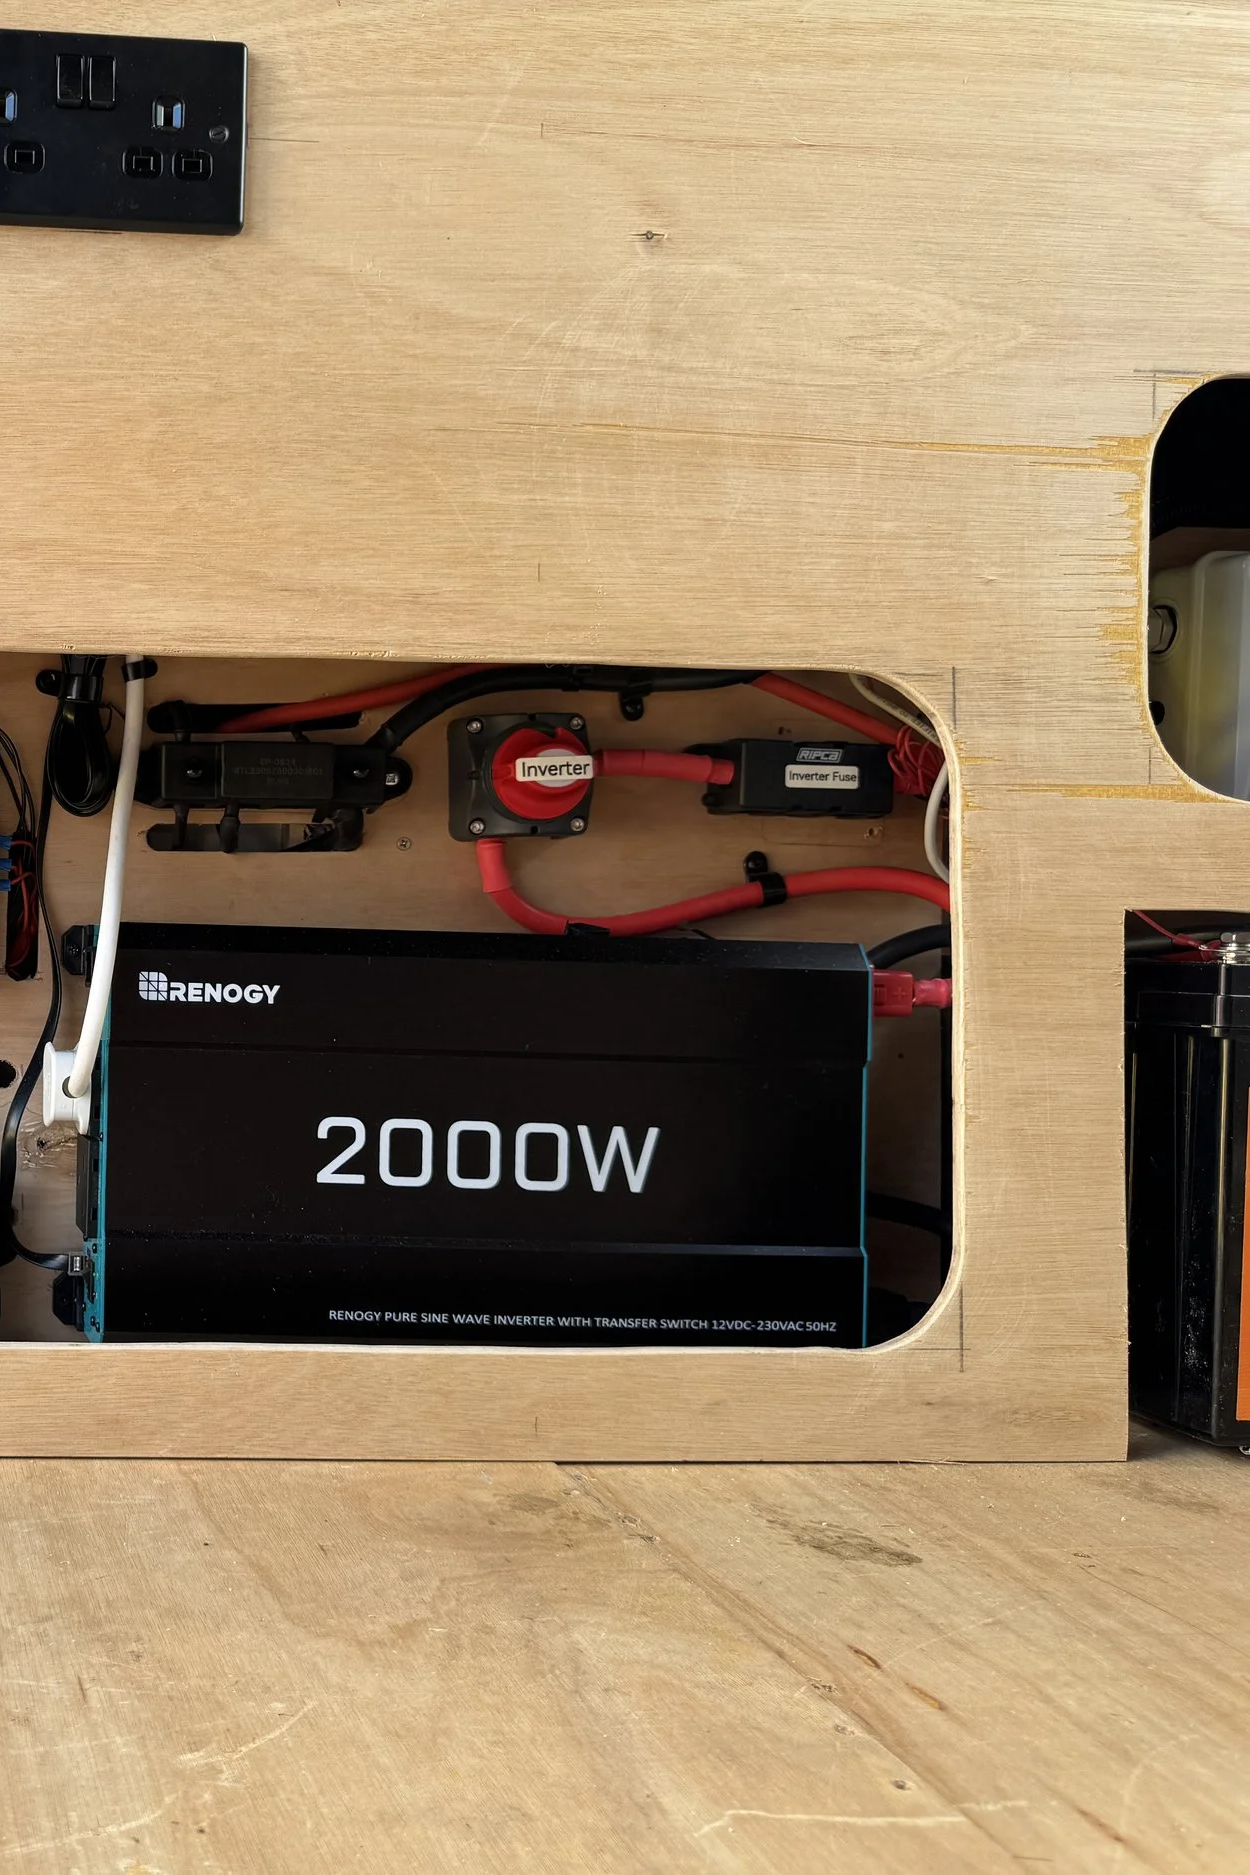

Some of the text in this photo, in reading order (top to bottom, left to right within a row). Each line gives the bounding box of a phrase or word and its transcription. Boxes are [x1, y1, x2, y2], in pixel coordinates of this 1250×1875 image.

[522, 761, 590, 778] Inverter
[789, 770, 857, 782] Inverter Fuse
[169, 982, 281, 1005] RENOGY
[316, 1116, 662, 1194] 2000W
[328, 1310, 382, 1322] RENOGY
[384, 1312, 418, 1323] PURE
[420, 1312, 449, 1324] SINE
[452, 1313, 491, 1325] WAVE
[493, 1314, 554, 1327] INVERTER
[557, 1316, 591, 1327] WITH
[594, 1317, 657, 1329] TRANSFER
[660, 1319, 708, 1330] SWITCH
[806, 1321, 837, 1332] 50HZ
